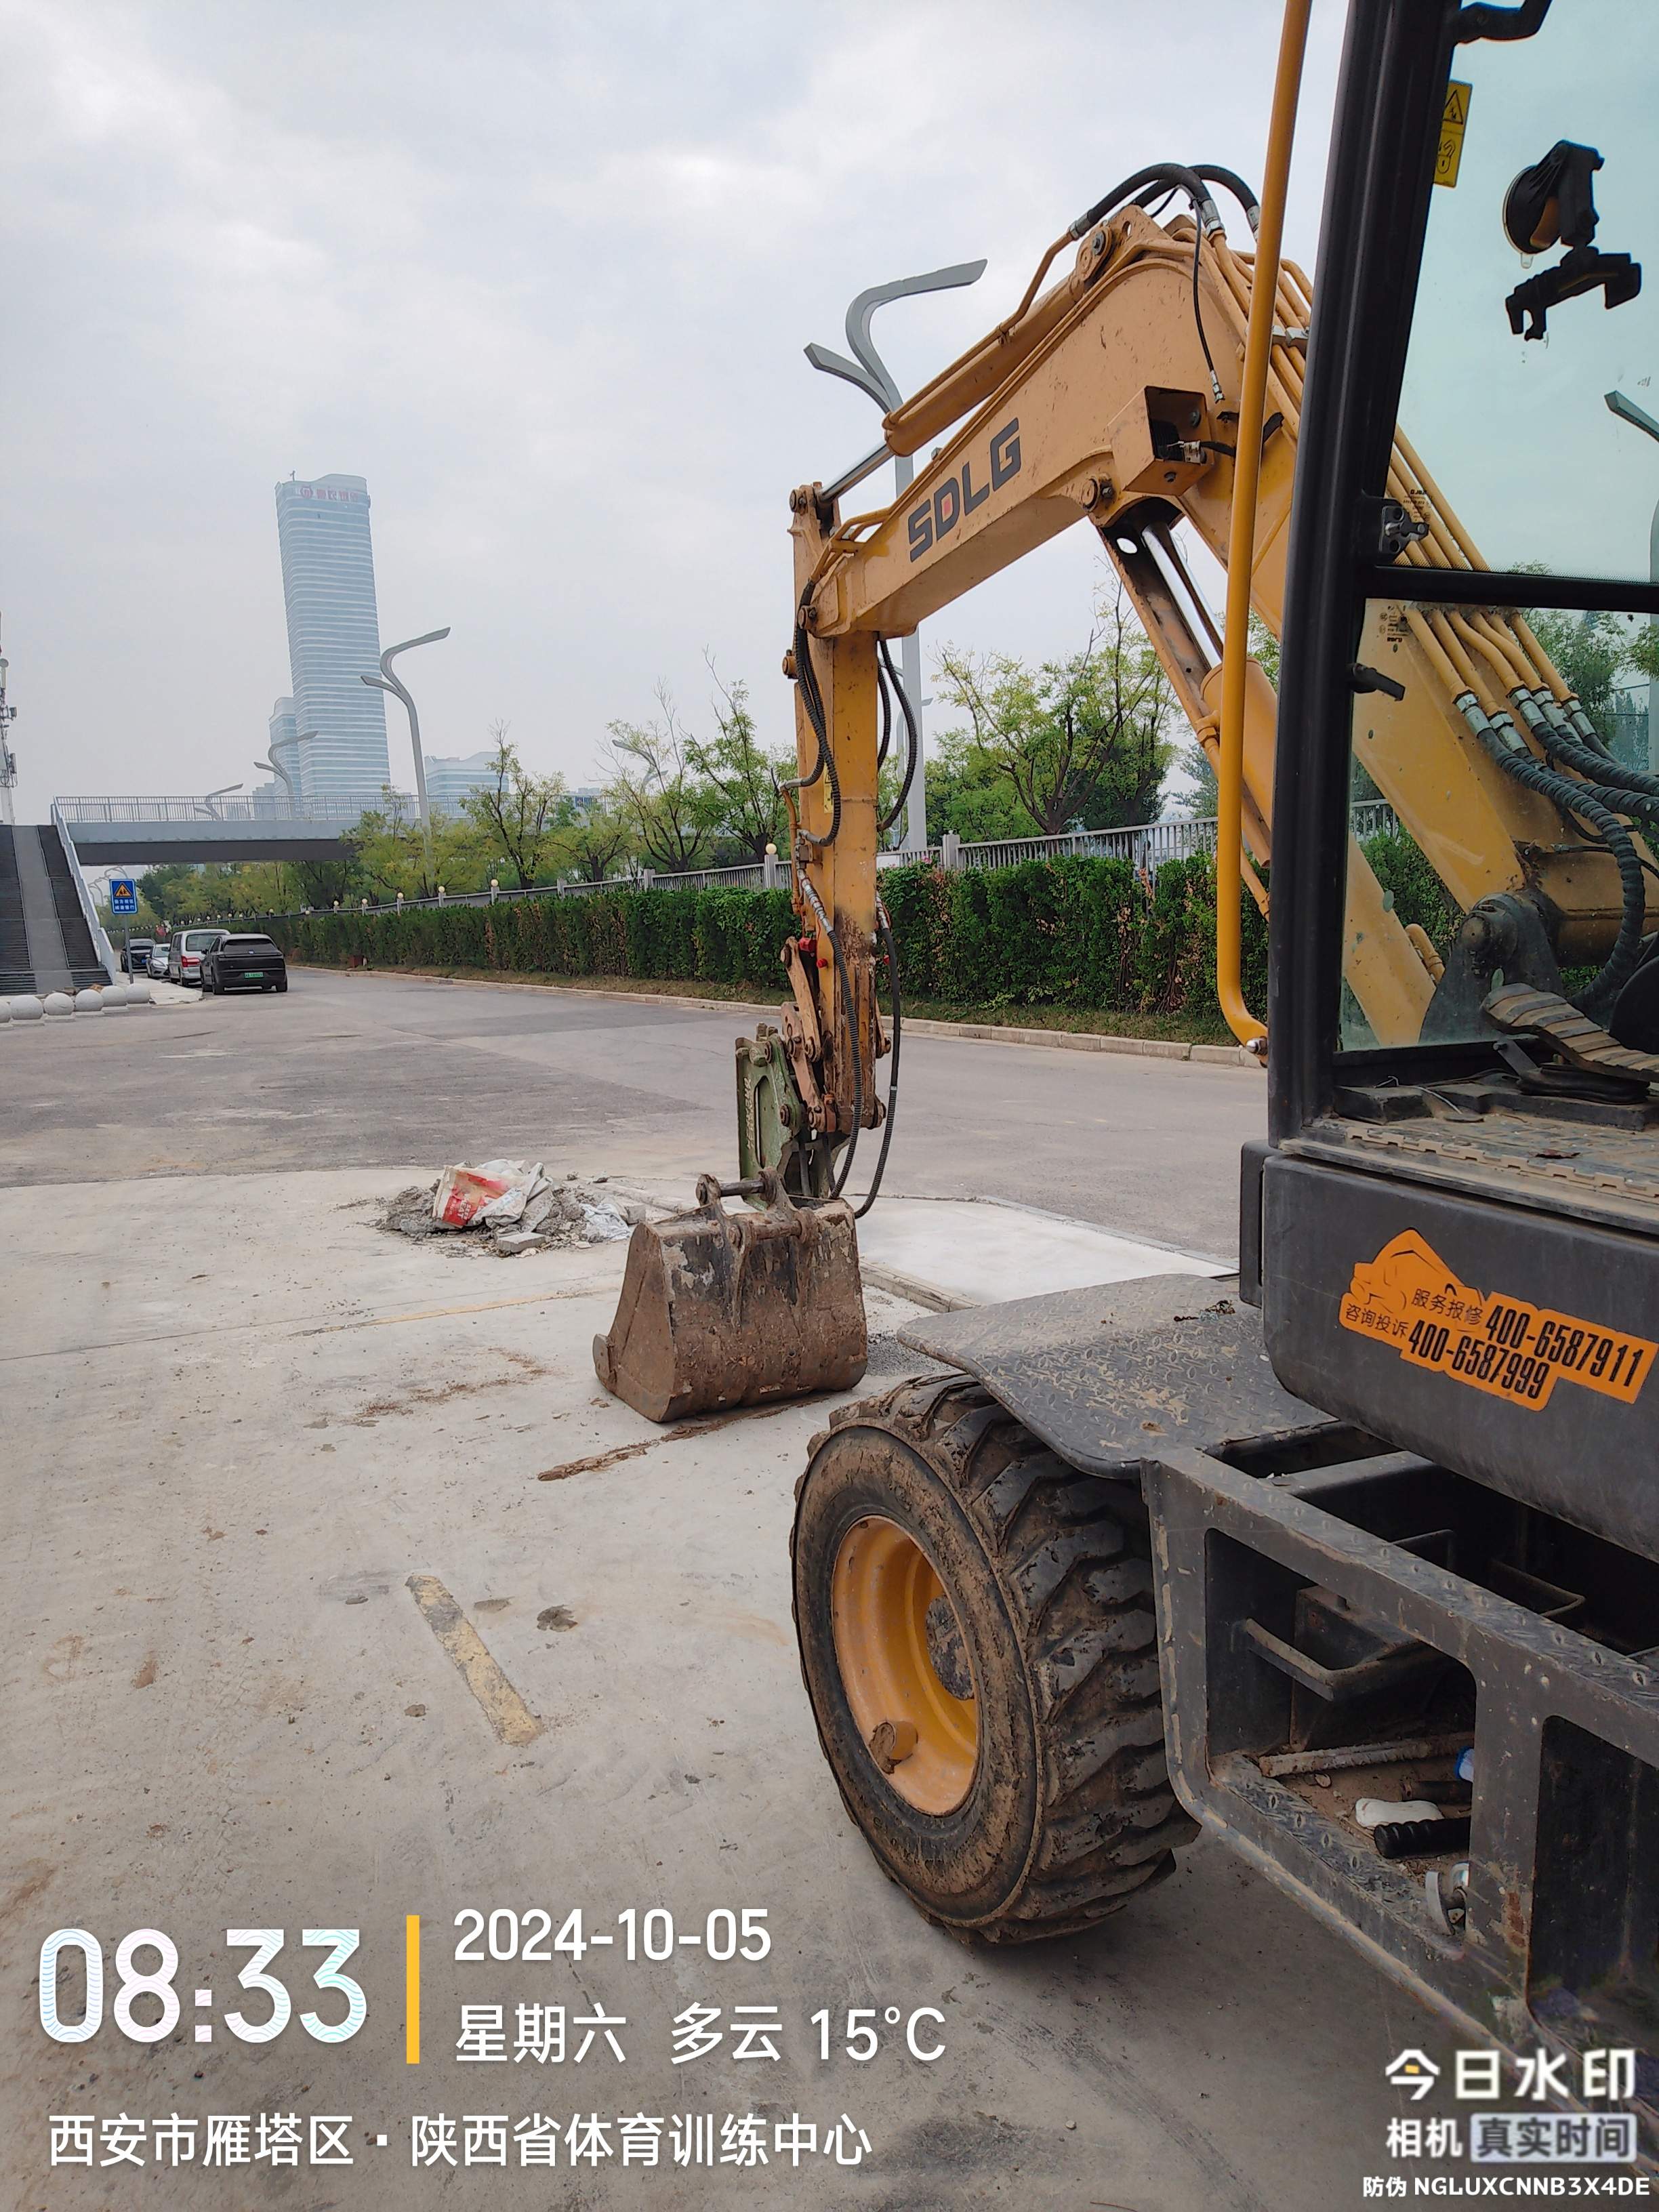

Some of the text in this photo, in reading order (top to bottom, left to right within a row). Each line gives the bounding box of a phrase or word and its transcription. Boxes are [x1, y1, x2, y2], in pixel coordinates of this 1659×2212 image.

[907, 417, 1021, 562] SDLG
[1346, 1303, 1550, 1399] 咨询投诉 400-6587999
[1411, 1288, 1643, 1387] 服务报修 400-6587911
